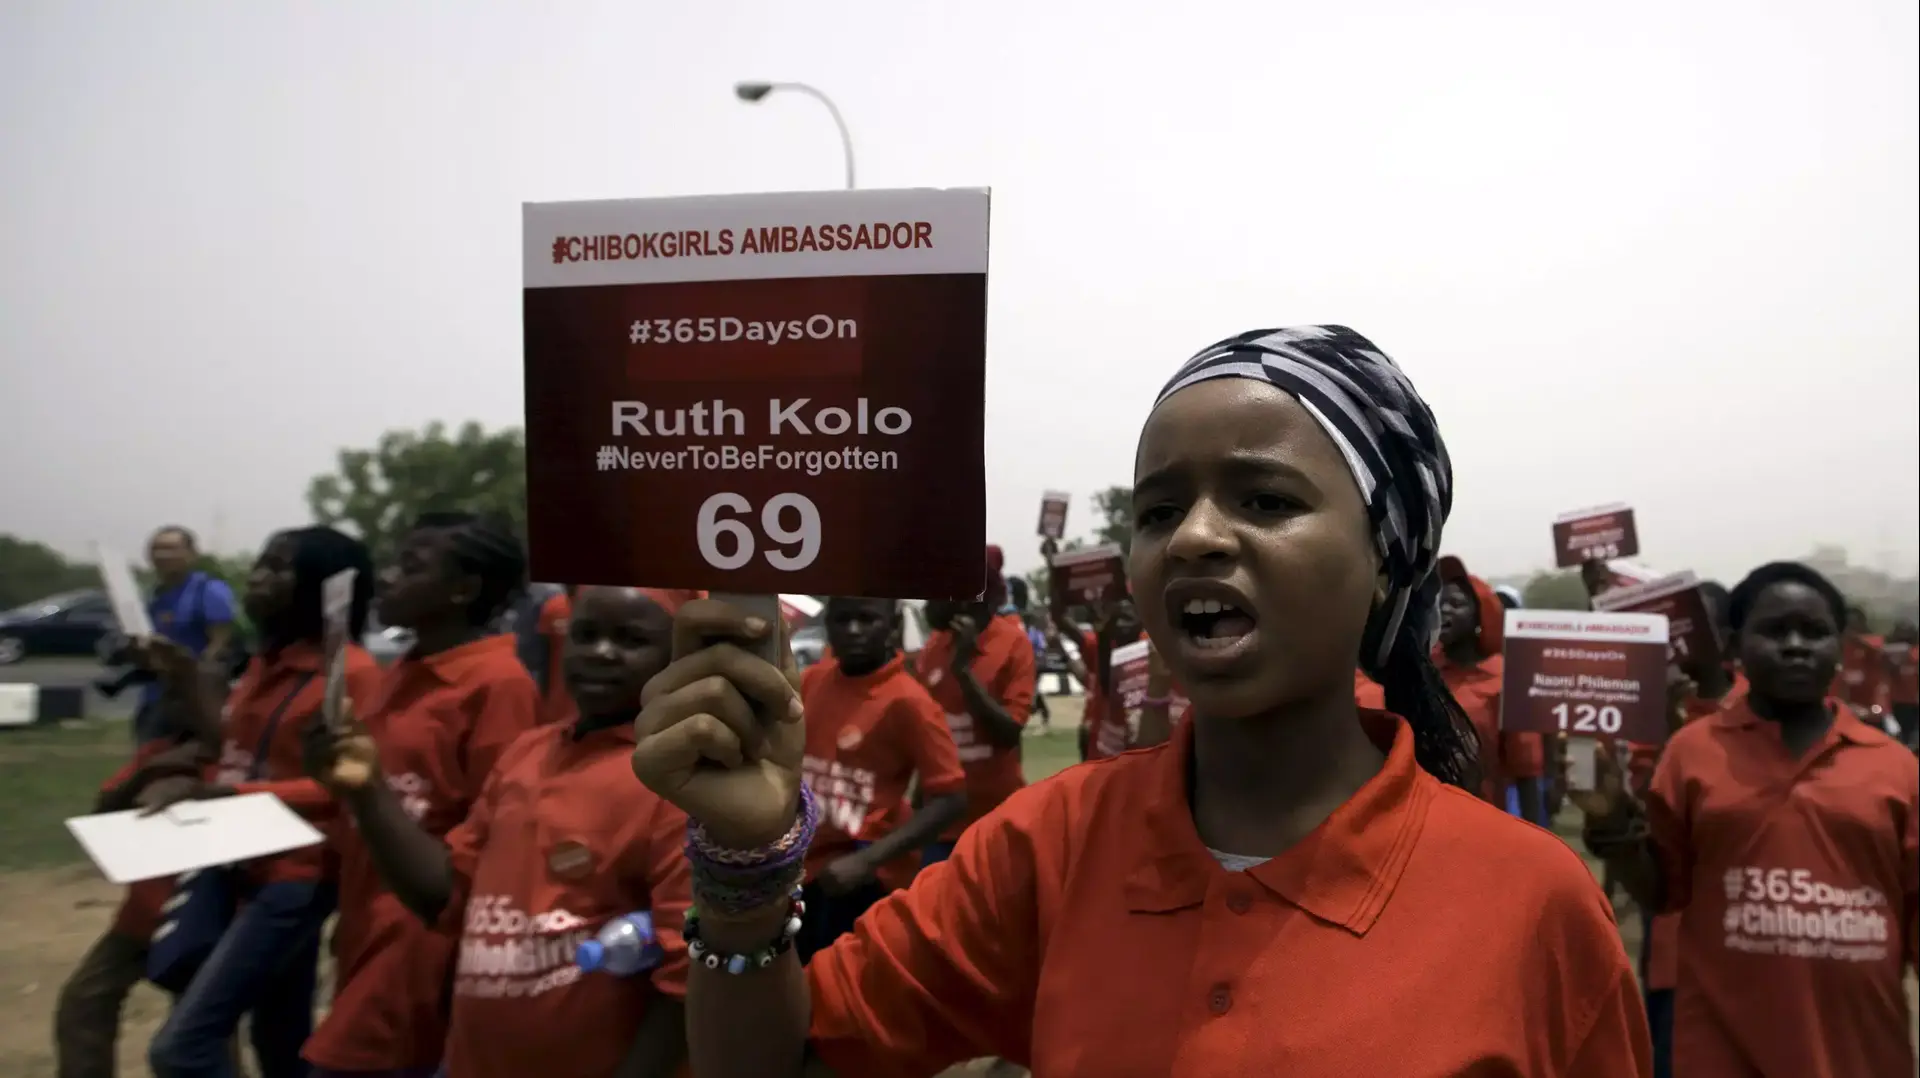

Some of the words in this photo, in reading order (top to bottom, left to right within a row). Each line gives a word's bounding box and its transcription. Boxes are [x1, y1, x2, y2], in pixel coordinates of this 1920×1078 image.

[552, 227, 734, 264] #CHIBOKGIRLS
[740, 221, 933, 255] AMBASSADOR
[629, 314, 858, 345] #365DaysOn
[611, 400, 745, 437] Ruth
[769, 397, 913, 436] Kolo
[596, 445, 898, 476] #NeverToBeForgotten
[696, 491, 822, 571] 69
[1533, 673, 1575, 688] Naomi
[1577, 674, 1641, 692] Philemon
[1551, 702, 1622, 734] 120
